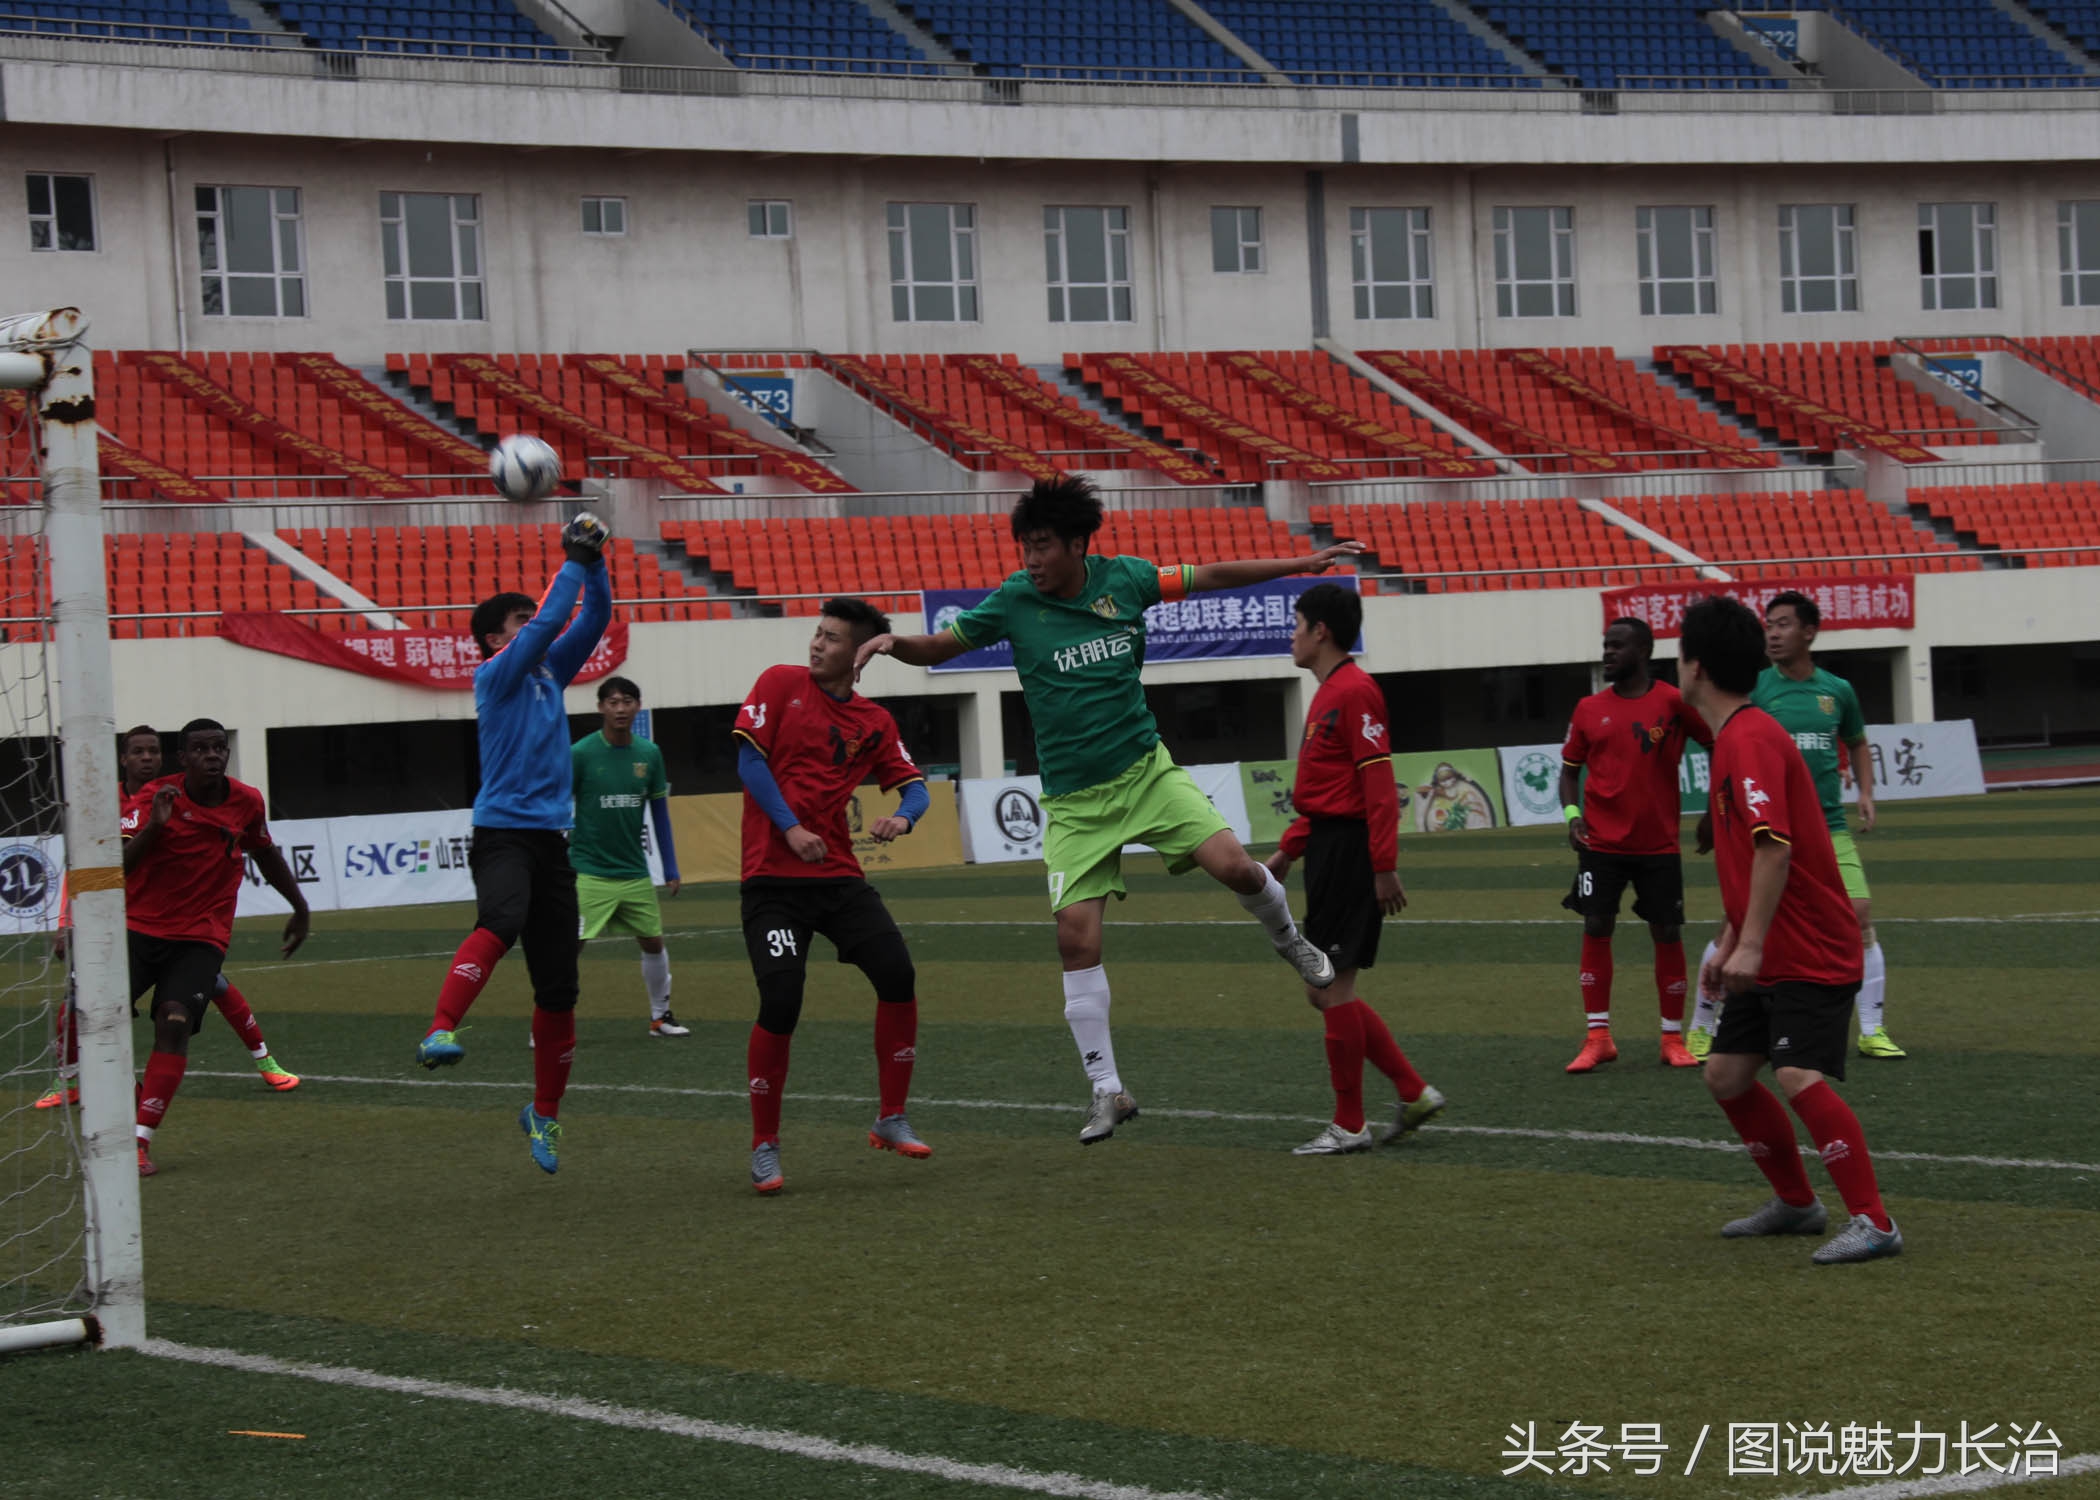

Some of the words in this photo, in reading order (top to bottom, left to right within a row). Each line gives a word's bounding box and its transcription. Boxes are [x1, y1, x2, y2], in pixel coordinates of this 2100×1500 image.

[1053, 631, 1132, 673] 优朋云
[1789, 732, 1832, 750] 朋云
[767, 929, 798, 958] 34
